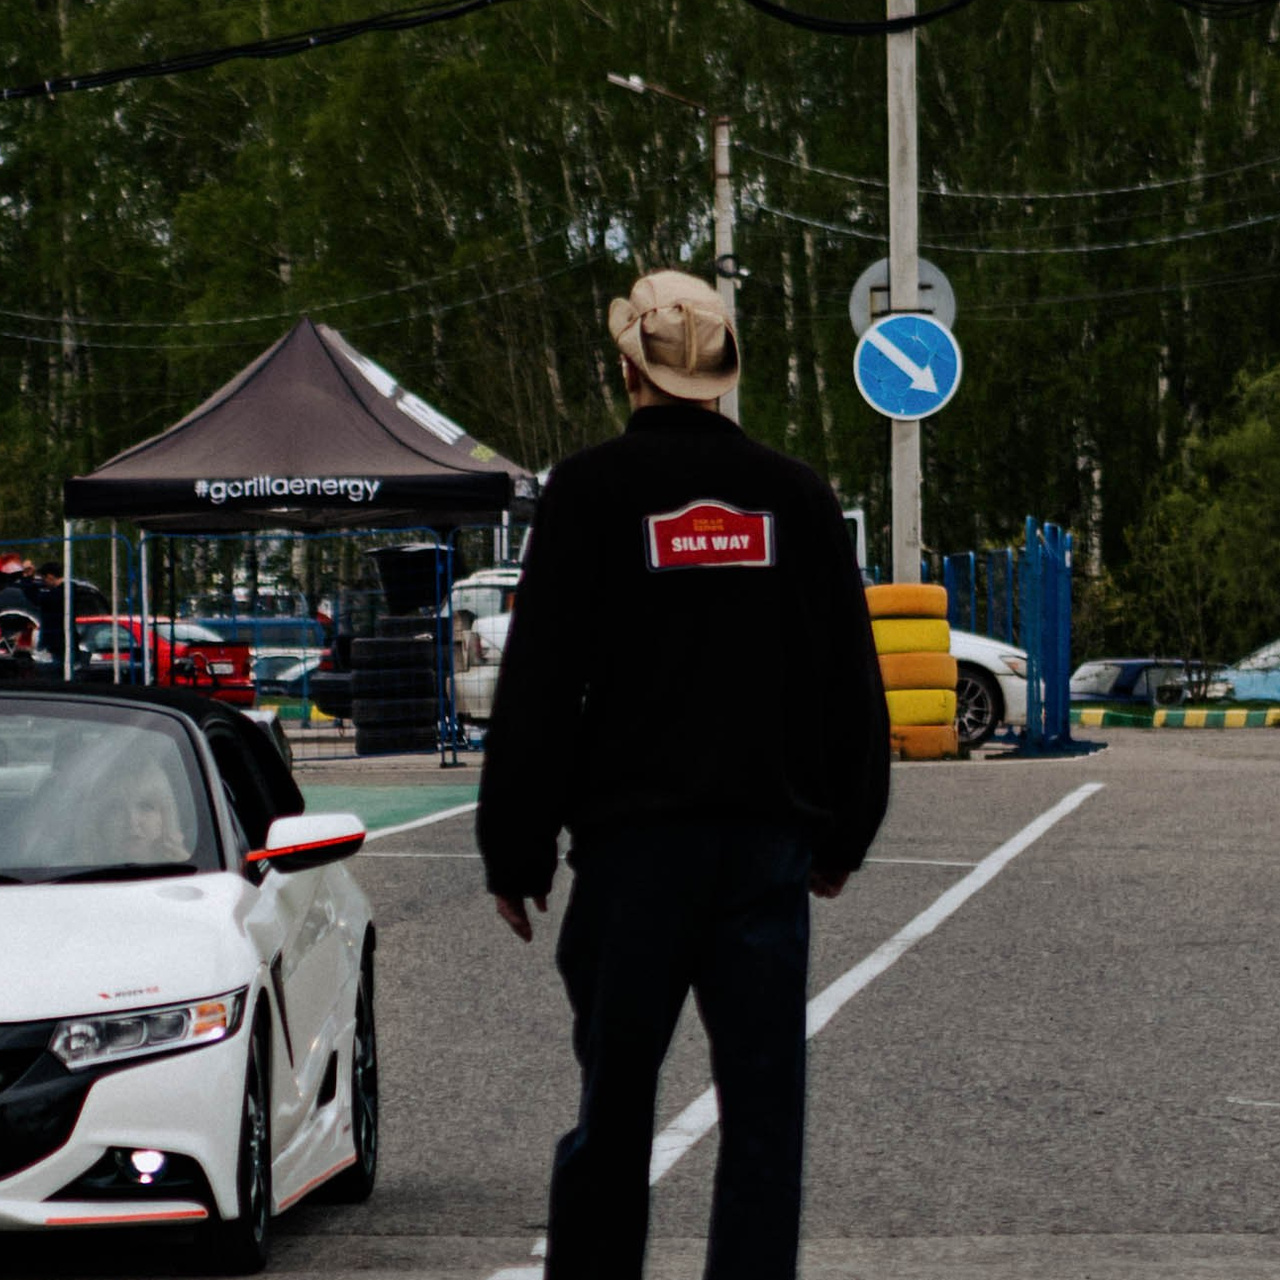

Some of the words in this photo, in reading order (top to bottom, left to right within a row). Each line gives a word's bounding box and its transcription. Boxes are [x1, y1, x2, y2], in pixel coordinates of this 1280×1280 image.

[194, 475, 381, 505] #gorillaenergy
[671, 535, 708, 553] SILK
[711, 534, 751, 551] WAY
